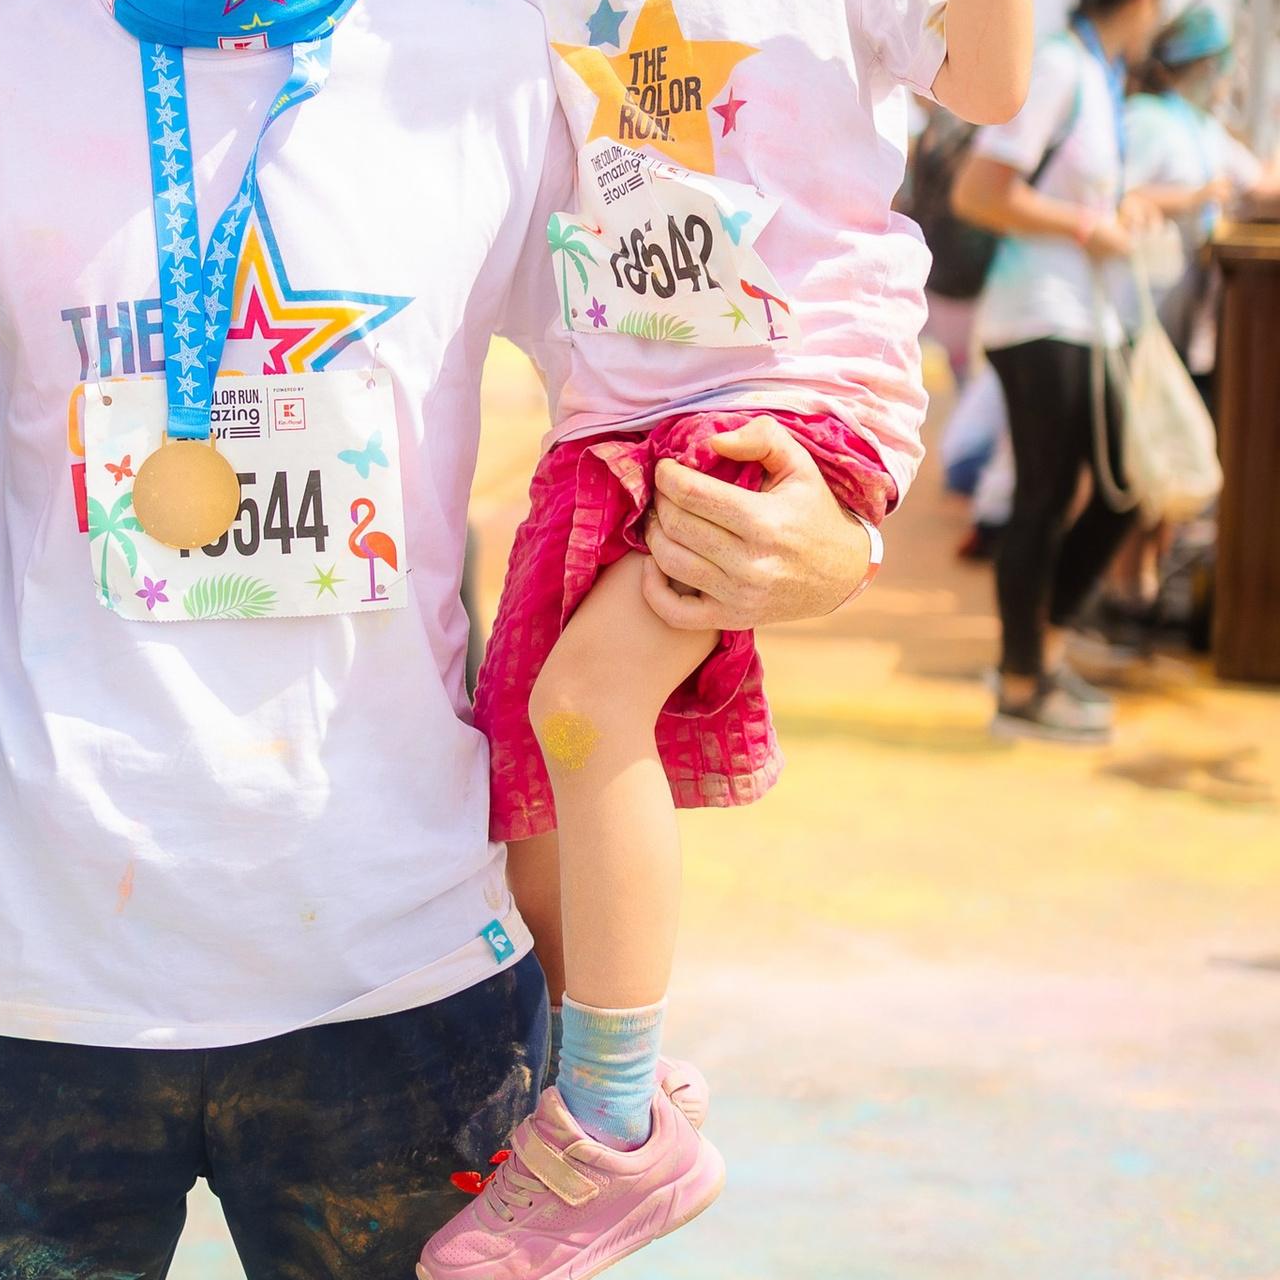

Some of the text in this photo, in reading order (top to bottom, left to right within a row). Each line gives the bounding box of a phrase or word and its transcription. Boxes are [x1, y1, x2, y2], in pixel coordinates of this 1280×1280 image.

[629, 45, 668, 86] THE
[624, 76, 702, 117] COLOR
[591, 154, 604, 173] THE
[597, 158, 641, 188] amazing
[606, 180, 630, 202] tour
[60, 298, 166, 381] THE
[211, 389, 236, 406] LOR
[210, 405, 260, 426] azing
[180, 469, 329, 558] 544
